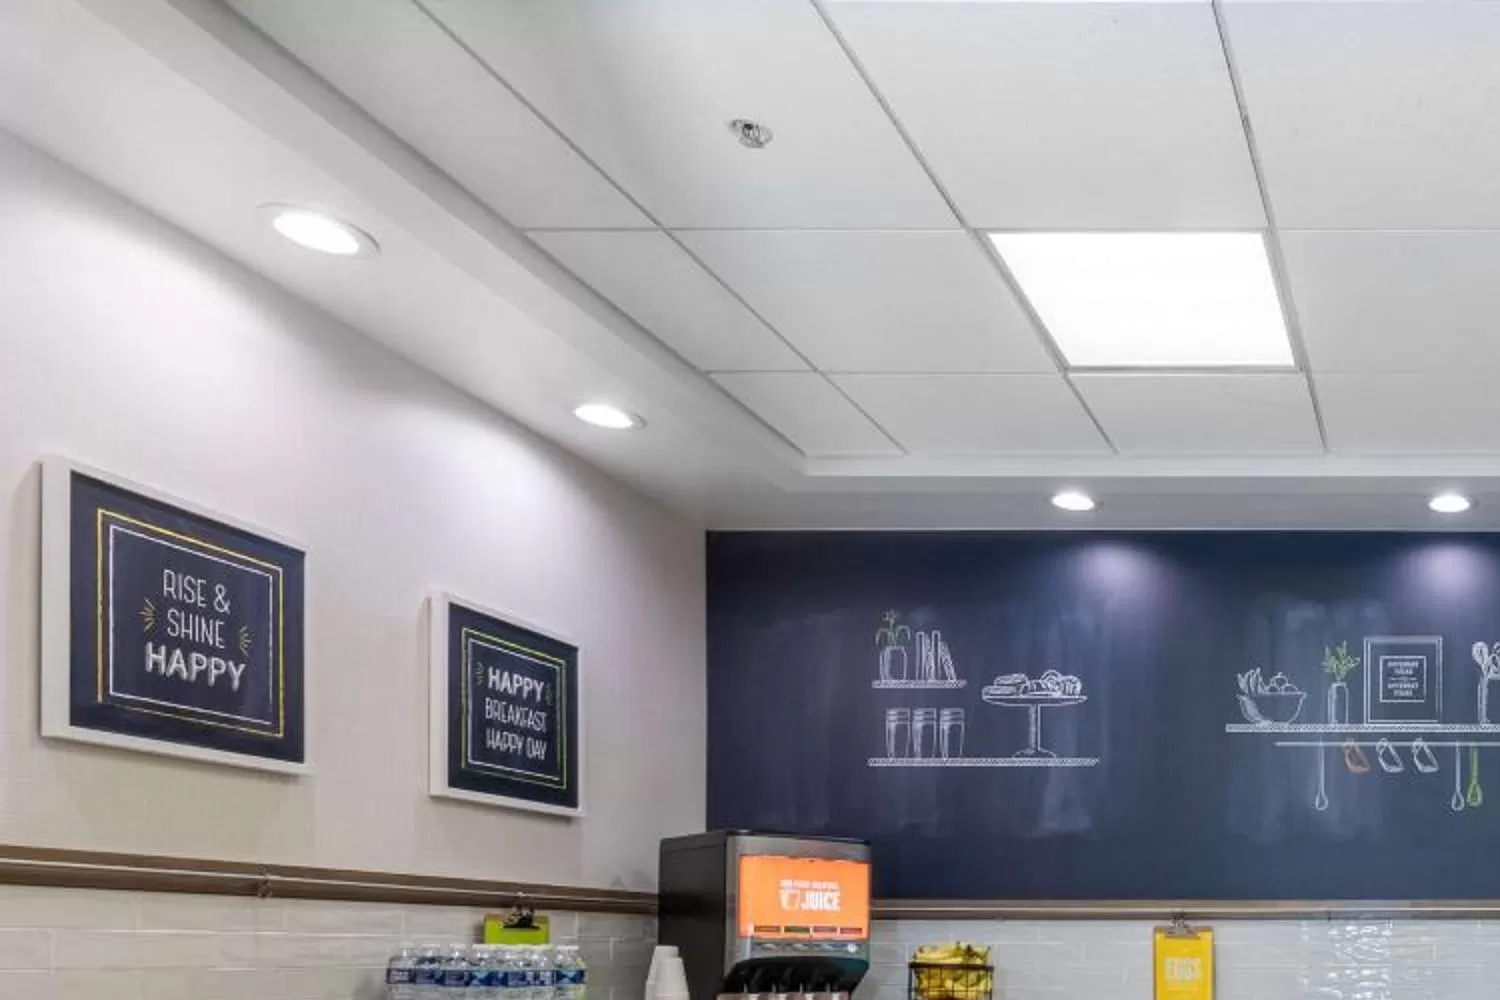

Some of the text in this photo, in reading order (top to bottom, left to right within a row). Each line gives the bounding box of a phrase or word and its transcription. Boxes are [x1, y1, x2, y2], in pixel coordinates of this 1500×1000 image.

[163, 568, 231, 615] RISE &
[167, 607, 226, 649] SHINE
[145, 640, 246, 693] HAPPY
[487, 665, 545, 703] HAPPY
[484, 696, 549, 734] BREAKFAST
[485, 727, 548, 760] HAPPY DAY
[800, 891, 842, 911] JUICE
